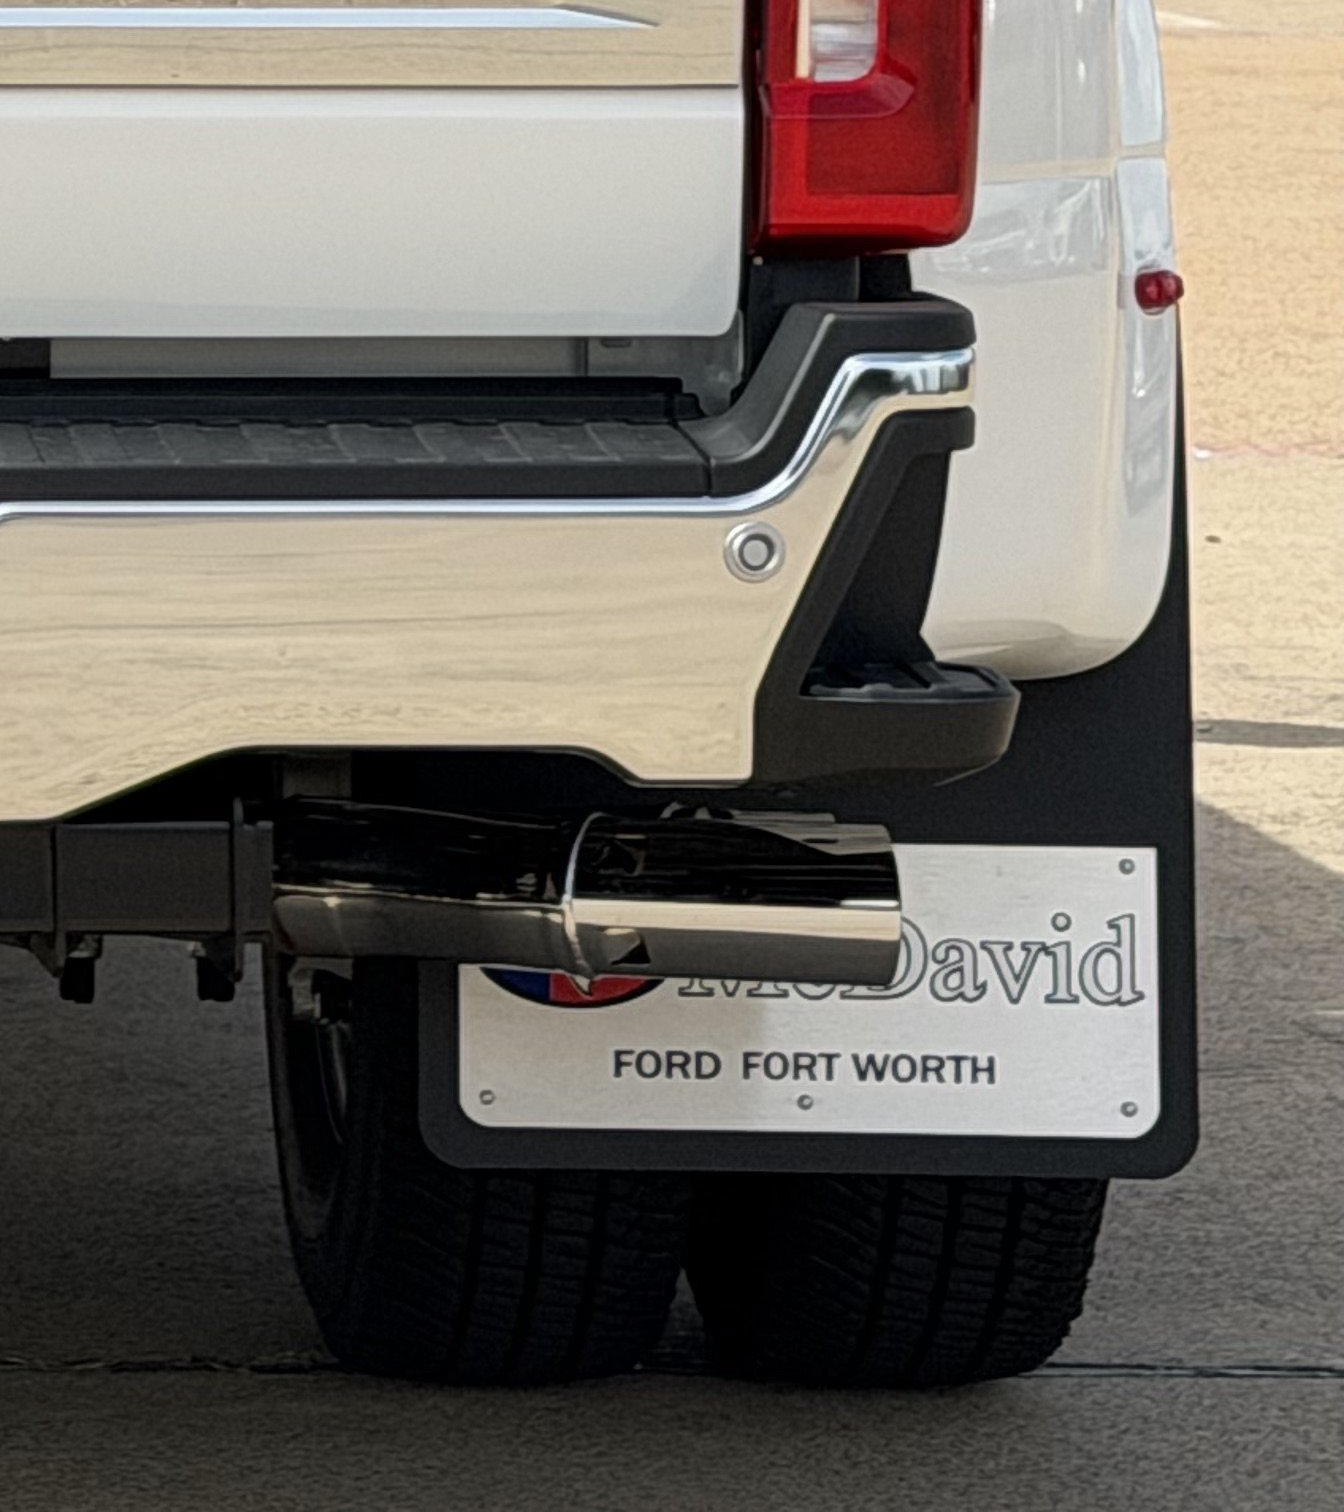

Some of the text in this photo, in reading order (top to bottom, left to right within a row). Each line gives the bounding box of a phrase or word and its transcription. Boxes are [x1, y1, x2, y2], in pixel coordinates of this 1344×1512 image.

[612, 1049, 996, 1085] FORD FORT WORTH
